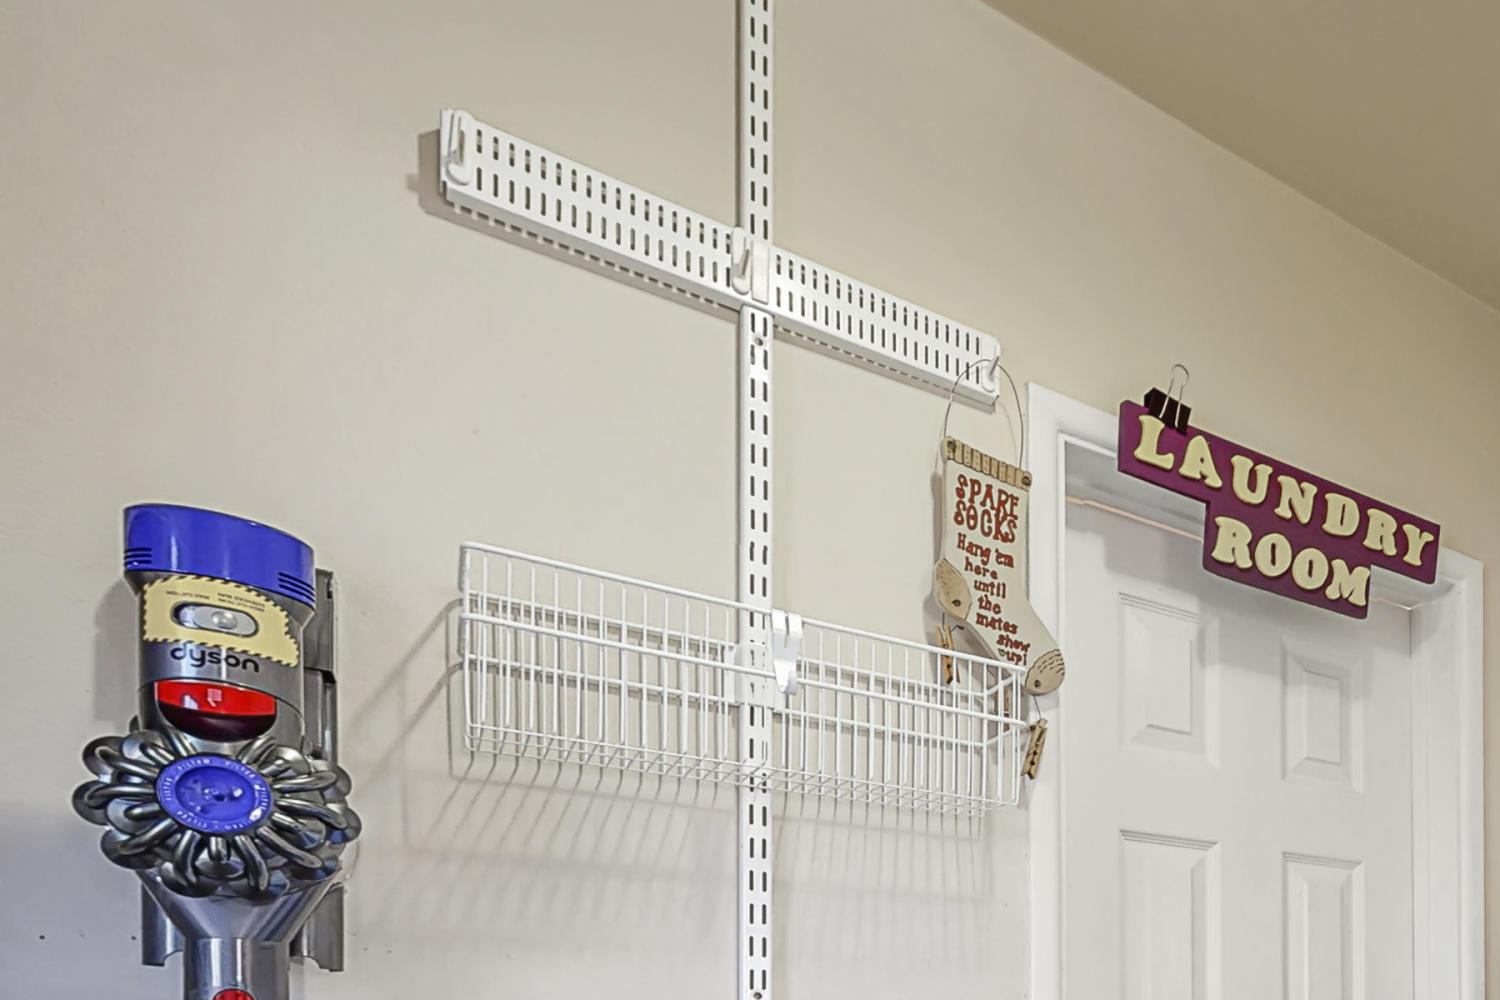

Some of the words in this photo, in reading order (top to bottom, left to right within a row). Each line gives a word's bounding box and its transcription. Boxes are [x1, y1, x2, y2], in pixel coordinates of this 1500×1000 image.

[955, 474, 1020, 520] SPARE
[1133, 414, 1435, 567] LAUNDRY
[953, 499, 1018, 543] SOCKS
[957, 532, 991, 566] Hang
[1210, 515, 1371, 607] ROOM
[964, 556, 998, 580] here
[974, 580, 1006, 599] until
[978, 594, 1002, 615] the
[976, 612, 1018, 635] mates
[170, 641, 260, 673] dyson
[996, 634, 1031, 653] show
